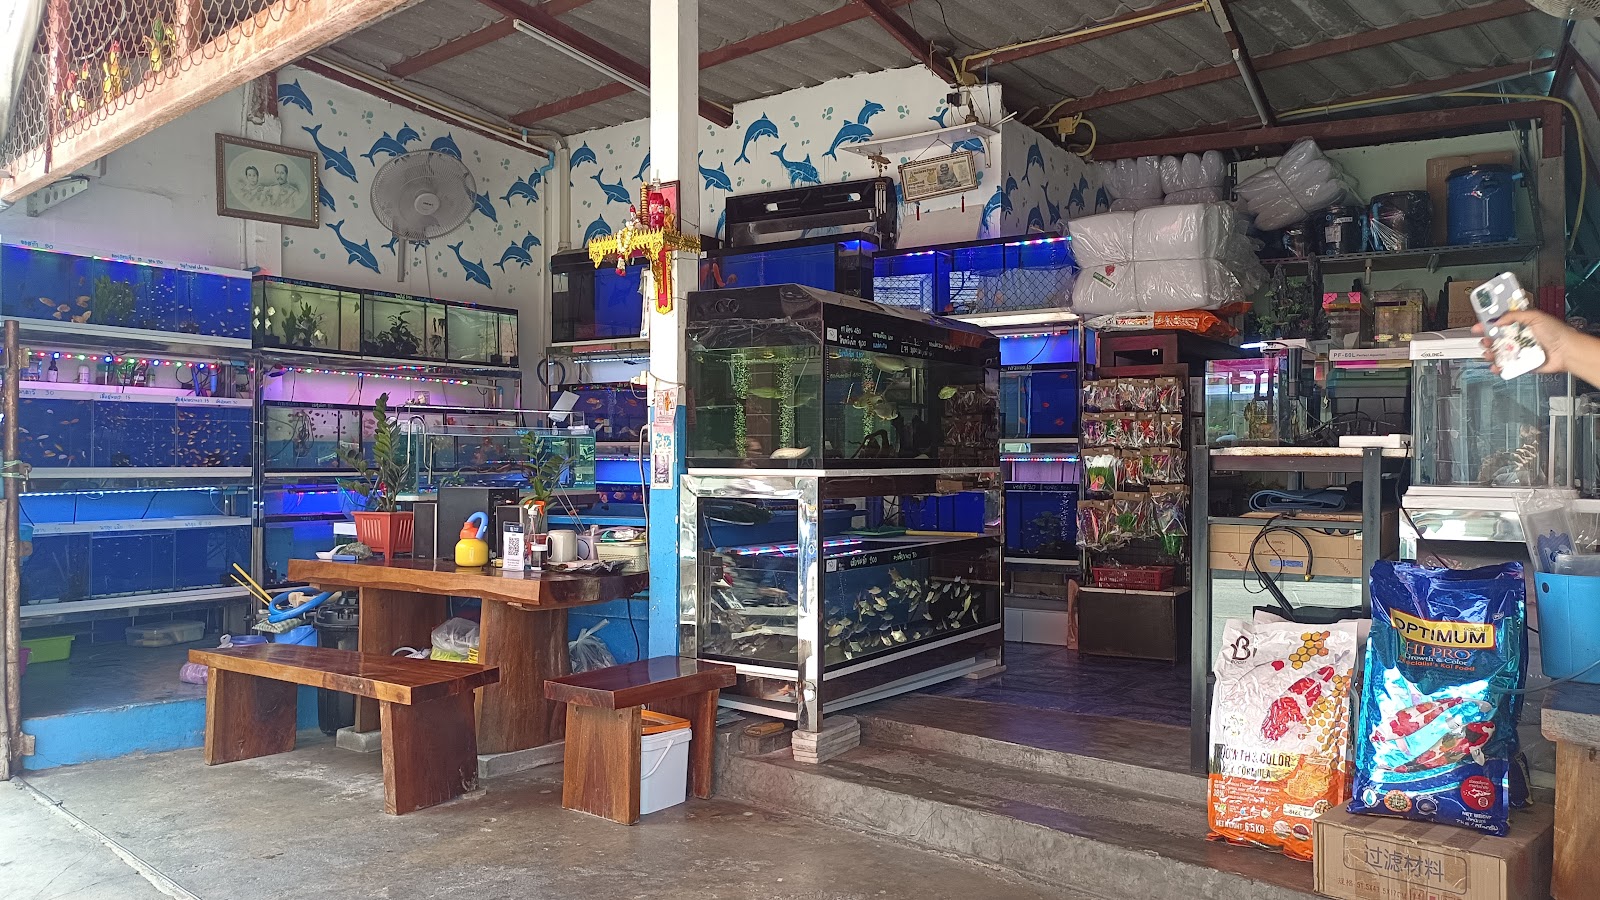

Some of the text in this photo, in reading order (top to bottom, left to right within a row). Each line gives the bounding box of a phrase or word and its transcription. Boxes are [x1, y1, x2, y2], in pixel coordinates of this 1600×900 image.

[1394, 617, 1486, 644] OPTIMUM
[1404, 652, 1434, 662] Growth
[1444, 658, 1468, 666] Color
[1406, 641, 1471, 660] HI PRO
[1454, 664, 1476, 672] Food
[1260, 752, 1291, 768] COLOR
[1364, 844, 1444, 882] 过滤材料
